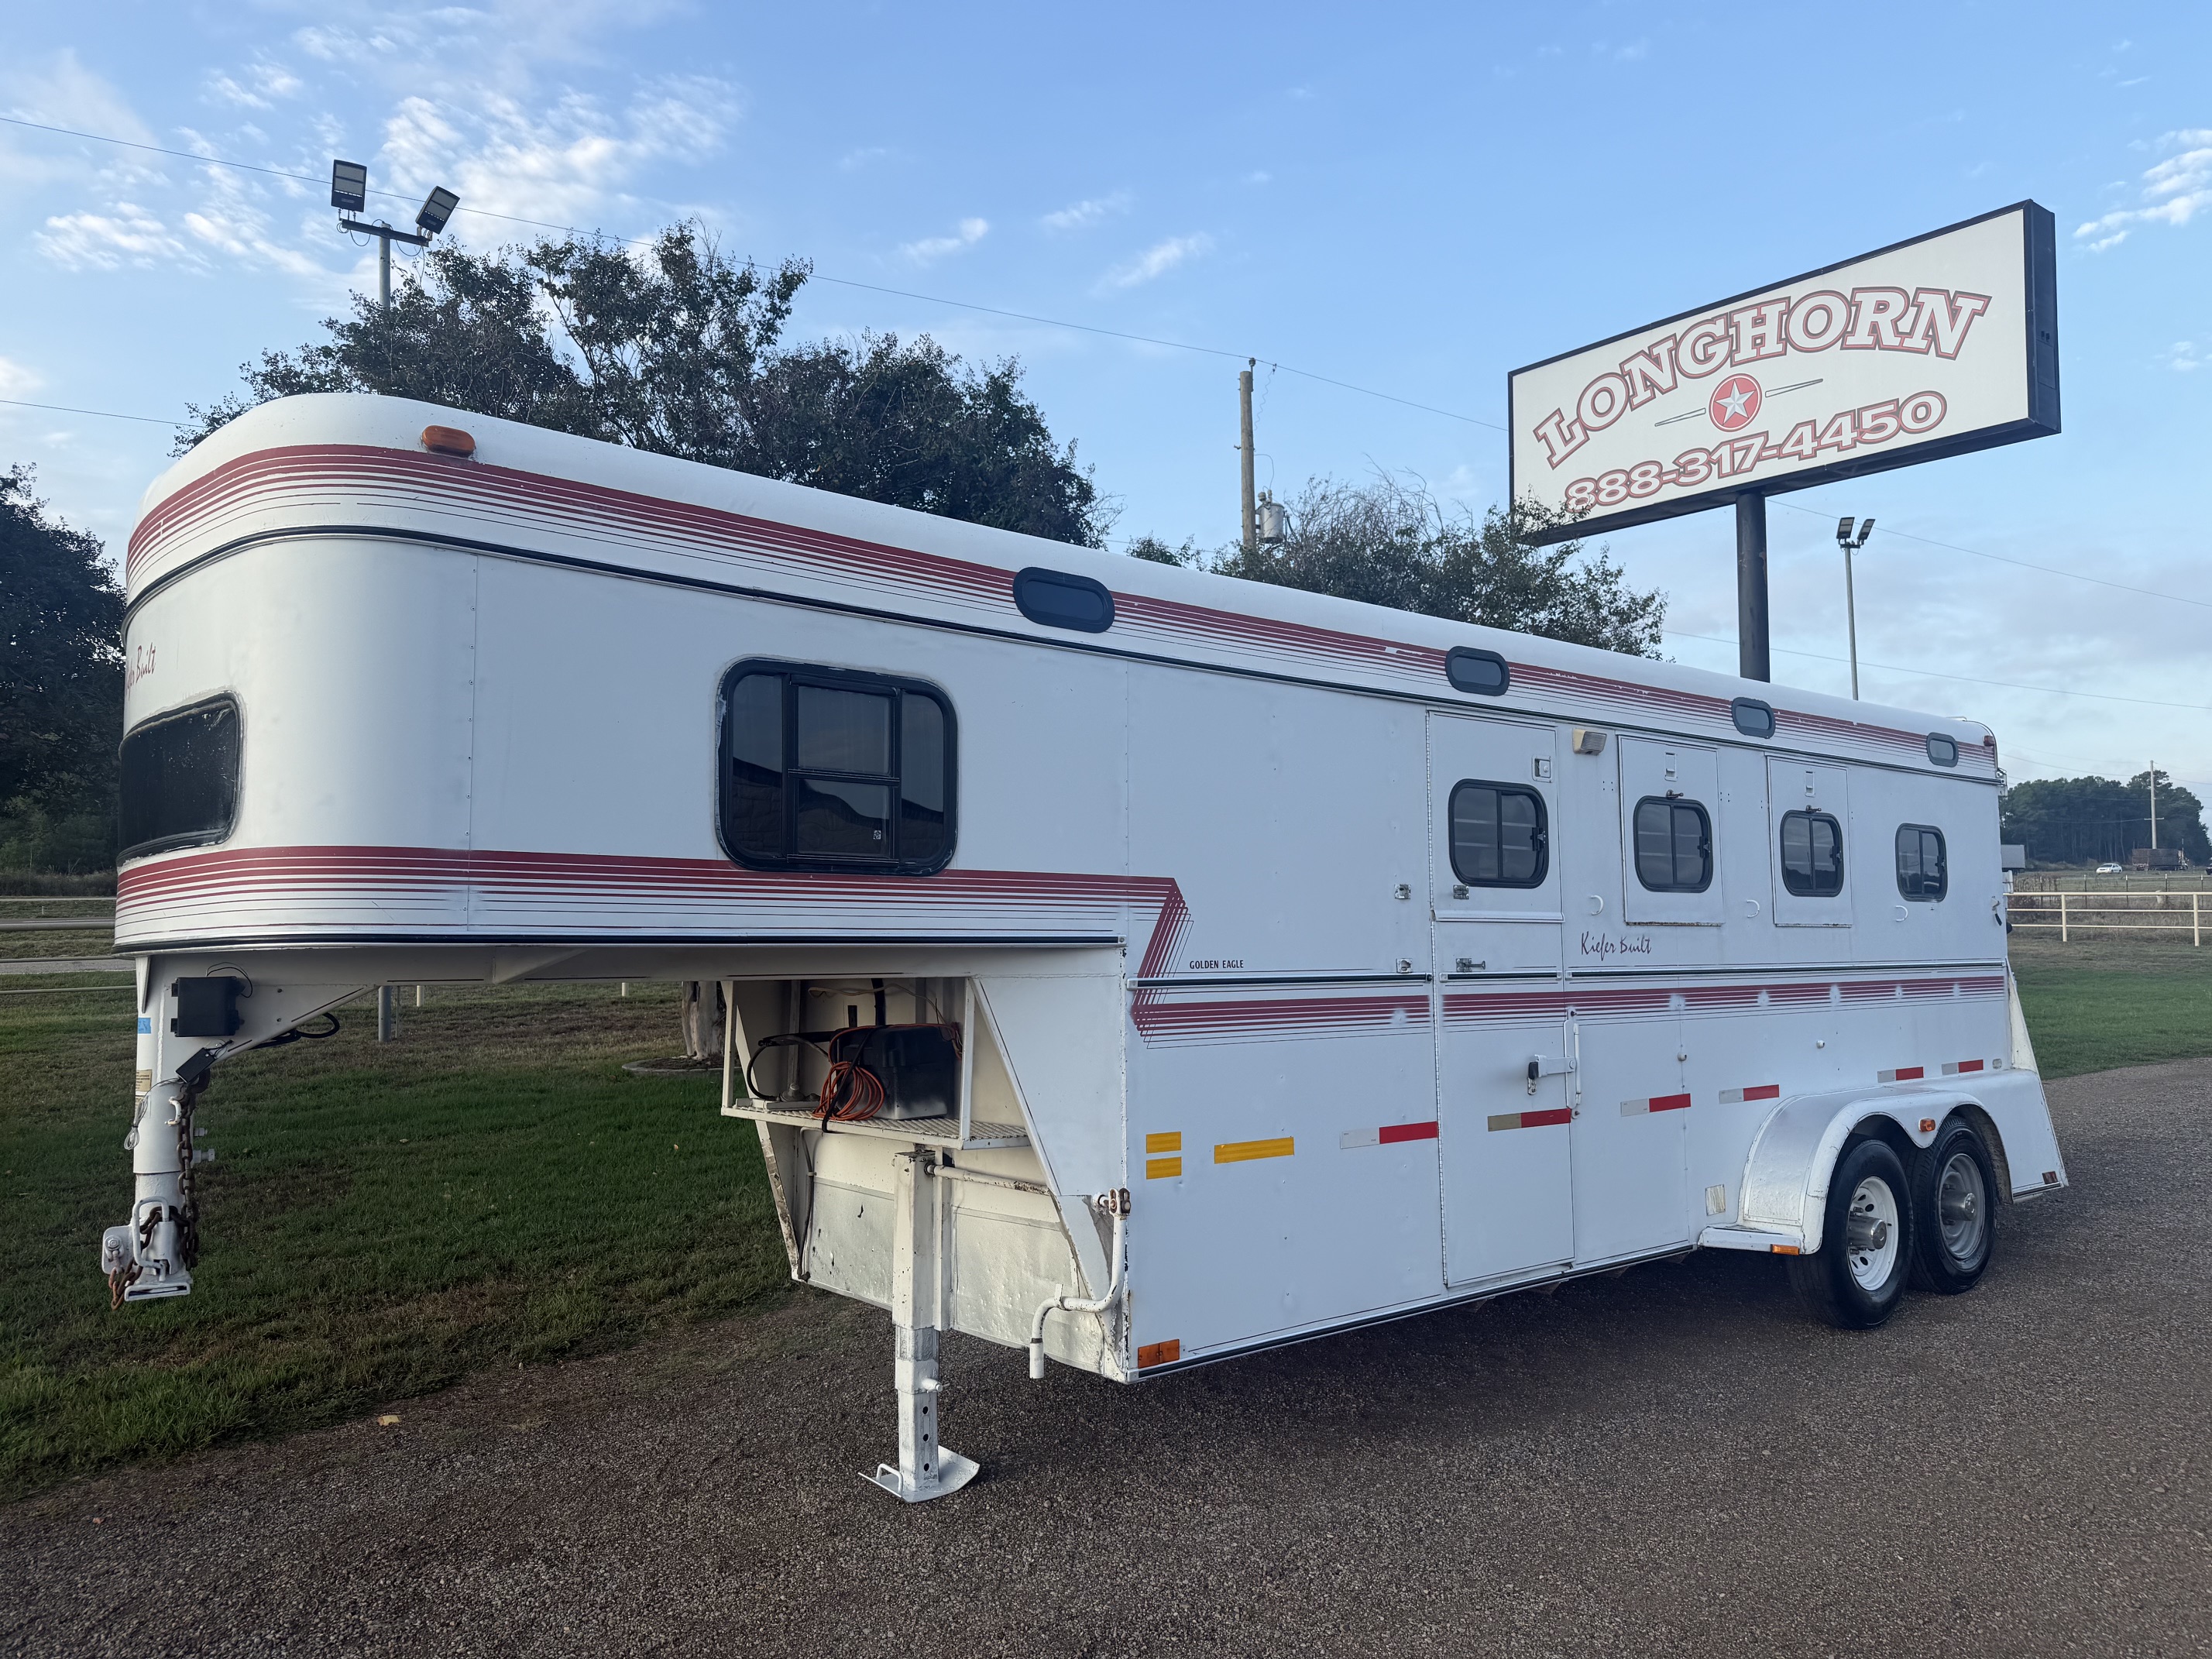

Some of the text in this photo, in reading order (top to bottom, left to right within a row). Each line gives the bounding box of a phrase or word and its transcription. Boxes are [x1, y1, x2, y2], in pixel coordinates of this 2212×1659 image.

[1533, 286, 1992, 470] LONGHORN
[1565, 390, 1947, 514] 888-317-4450
[136, 642, 156, 683] Built
[1190, 960, 1244, 969] GOLDEN EAGLE
[1581, 931, 1652, 961] Kiefer Built
